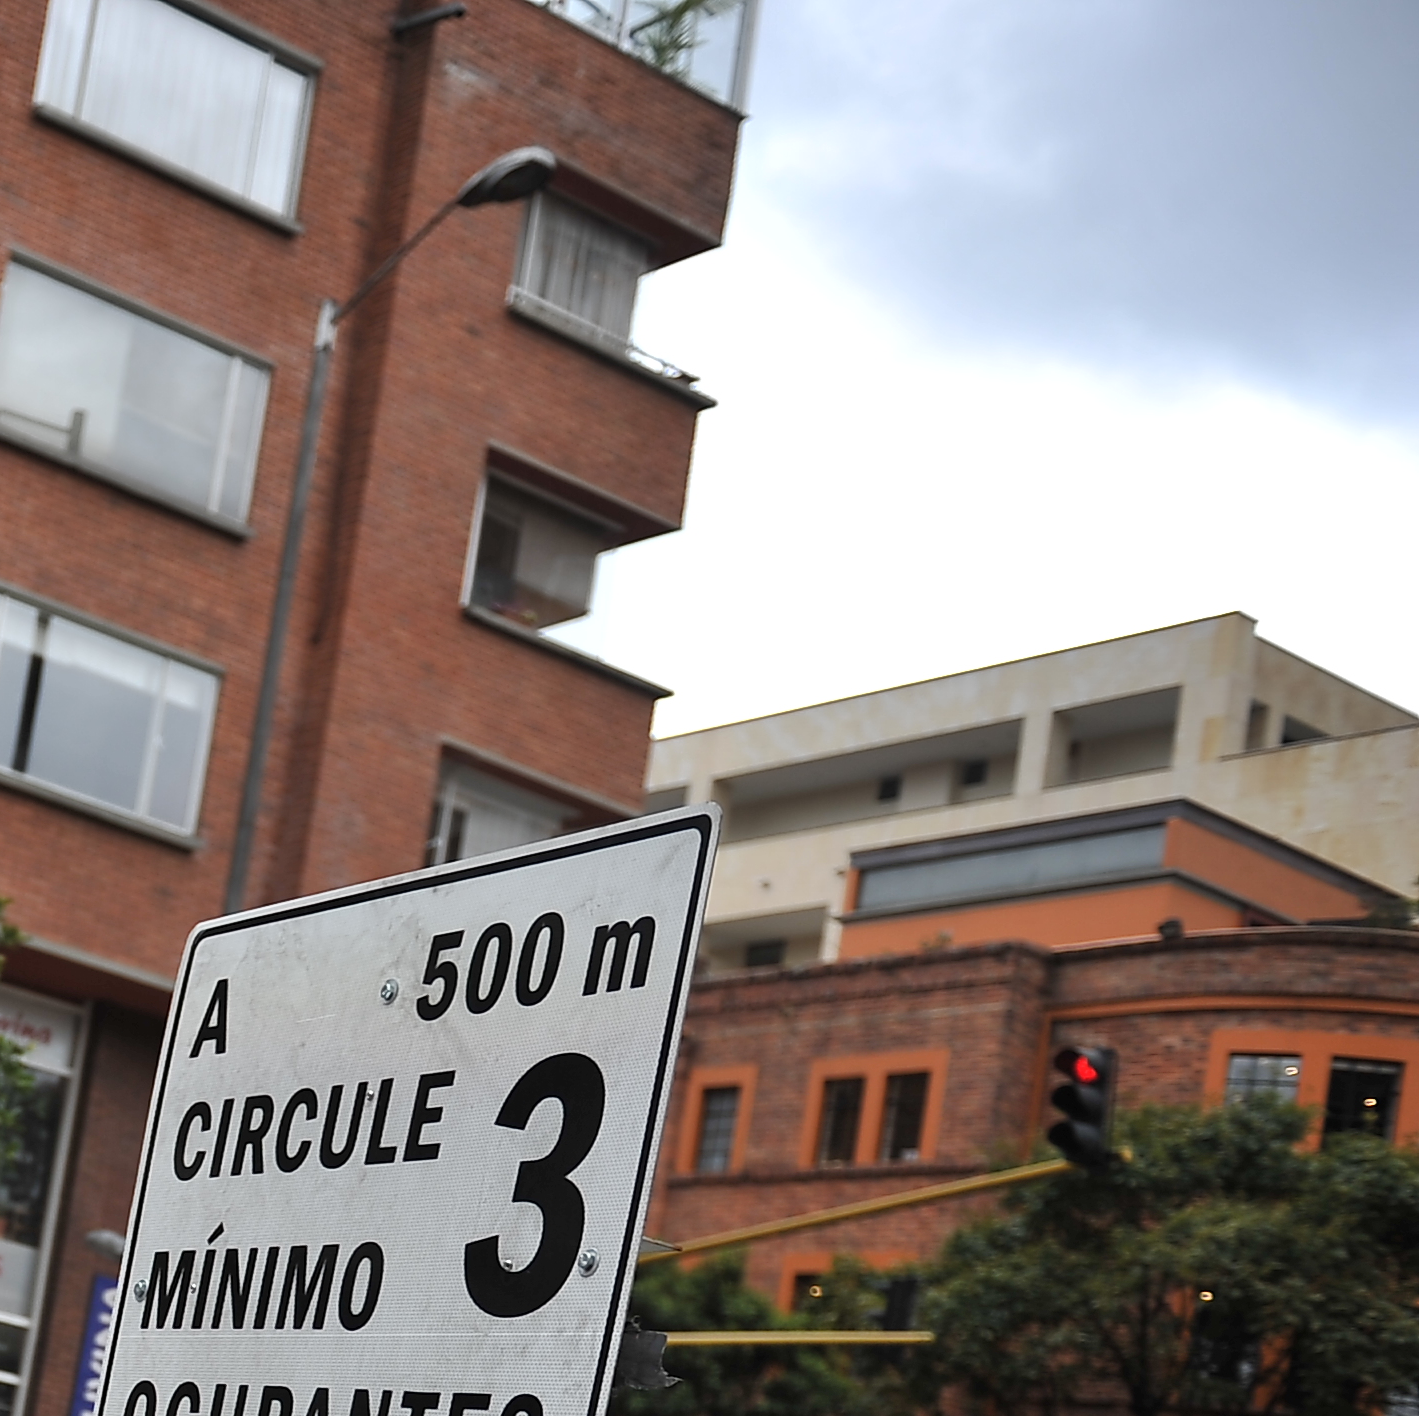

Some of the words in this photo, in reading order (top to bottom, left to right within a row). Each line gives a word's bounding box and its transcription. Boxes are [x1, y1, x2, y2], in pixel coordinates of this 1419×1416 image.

[189, 977, 229, 1058] A
[415, 911, 566, 1022] 500
[582, 915, 656, 997] m
[173, 1070, 457, 1182] CIRCULE
[464, 1052, 606, 1318] 3
[140, 1222, 385, 1332] MÍNIMO
